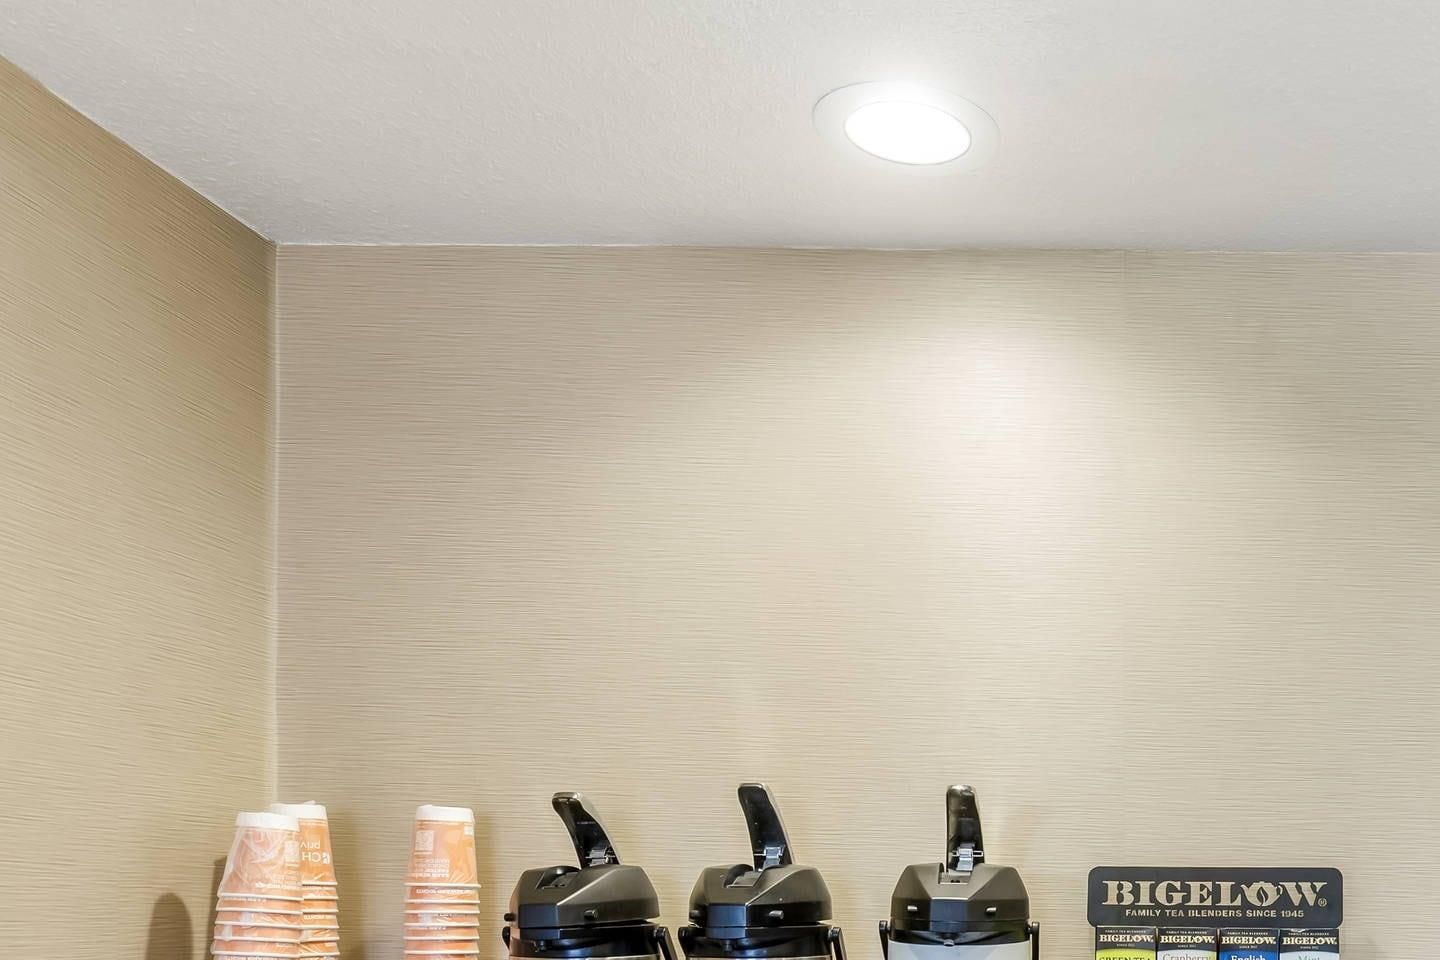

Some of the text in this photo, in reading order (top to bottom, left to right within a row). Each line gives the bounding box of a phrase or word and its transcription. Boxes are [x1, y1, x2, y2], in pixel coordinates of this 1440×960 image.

[1102, 880, 1328, 906] BIGELOW
[1125, 909, 1161, 917] FAMILY
[1165, 909, 1184, 917] TEA
[1188, 909, 1242, 917] BLENDERS
[1246, 909, 1277, 918] SINCE
[1100, 934, 1153, 943] BIGELOW
[1160, 935, 1214, 944] BIGELOW
[1222, 936, 1276, 945] BIGELOW
[1282, 937, 1337, 945] BIGELOW
